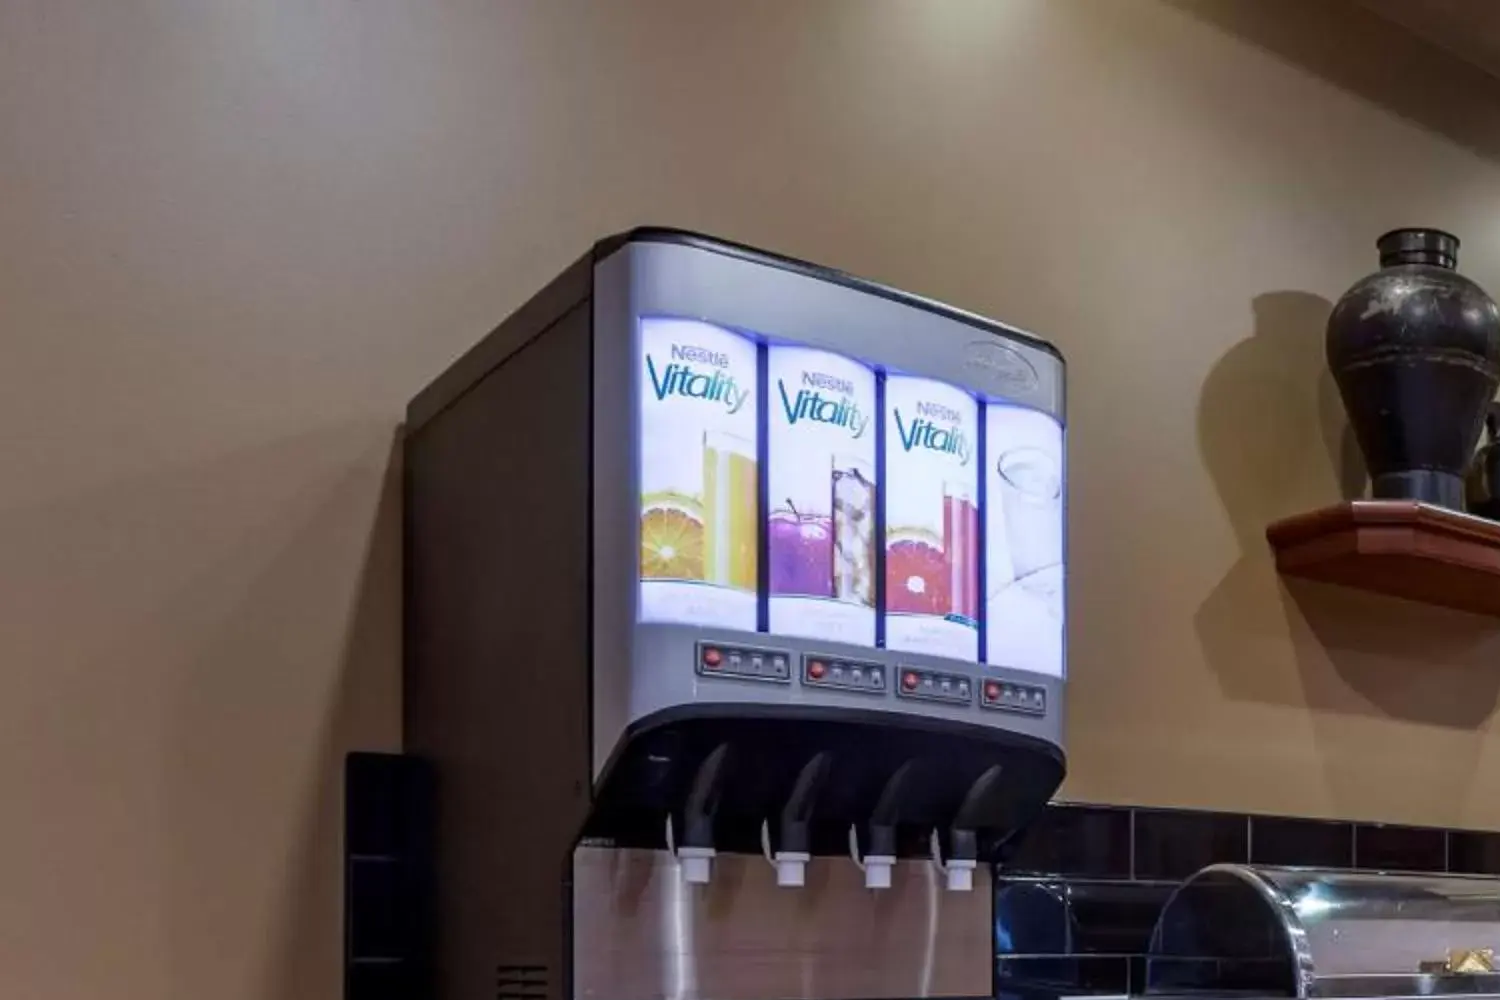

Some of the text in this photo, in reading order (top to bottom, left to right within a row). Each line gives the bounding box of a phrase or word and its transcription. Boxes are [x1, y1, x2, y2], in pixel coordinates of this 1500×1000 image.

[646, 352, 750, 415] Vitality
[777, 378, 869, 440] Vitality
[893, 406, 973, 467] Vitality
